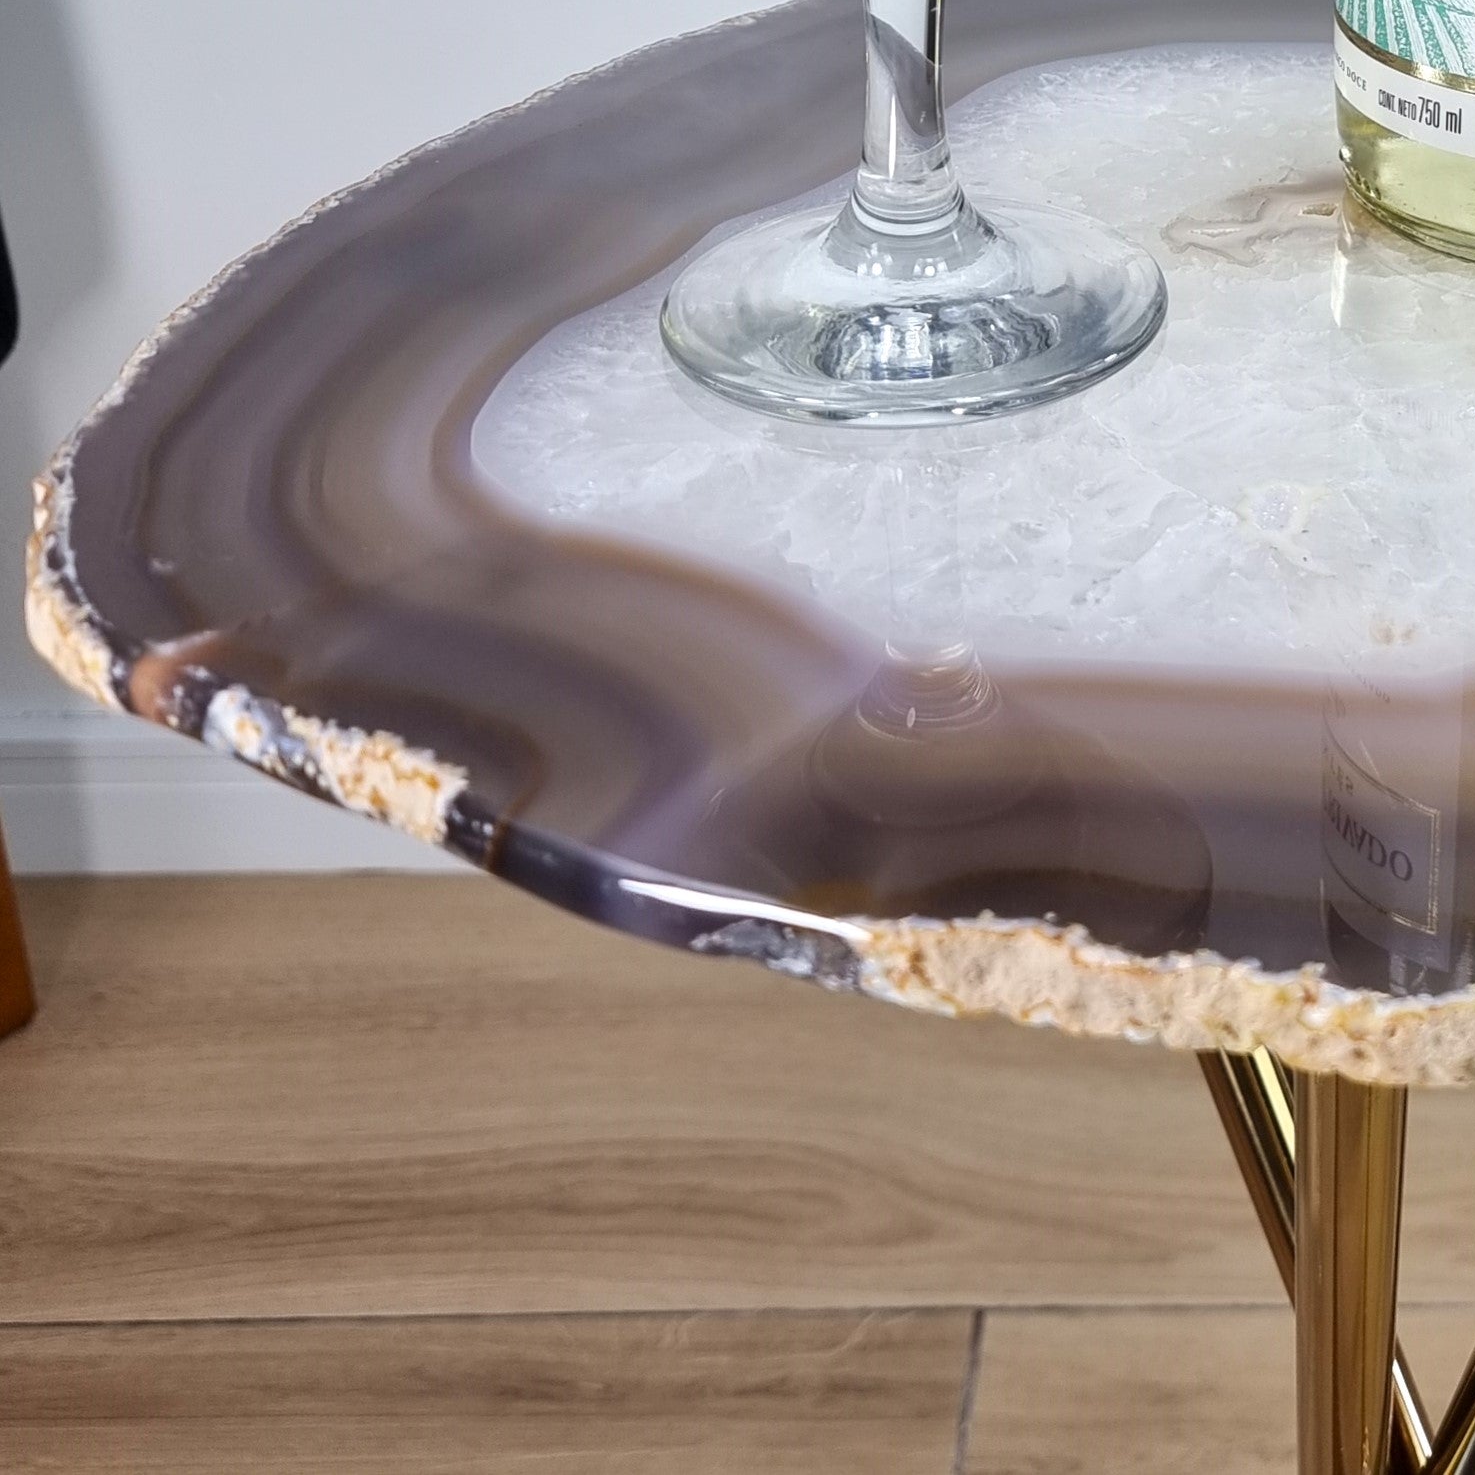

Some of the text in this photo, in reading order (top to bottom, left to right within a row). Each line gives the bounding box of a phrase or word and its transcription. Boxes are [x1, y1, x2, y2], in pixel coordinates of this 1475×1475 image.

[1346, 66, 1367, 91] DOCE
[1397, 97, 1417, 121] NETO
[1418, 96, 1440, 129] 750
[1445, 107, 1463, 135] ml
